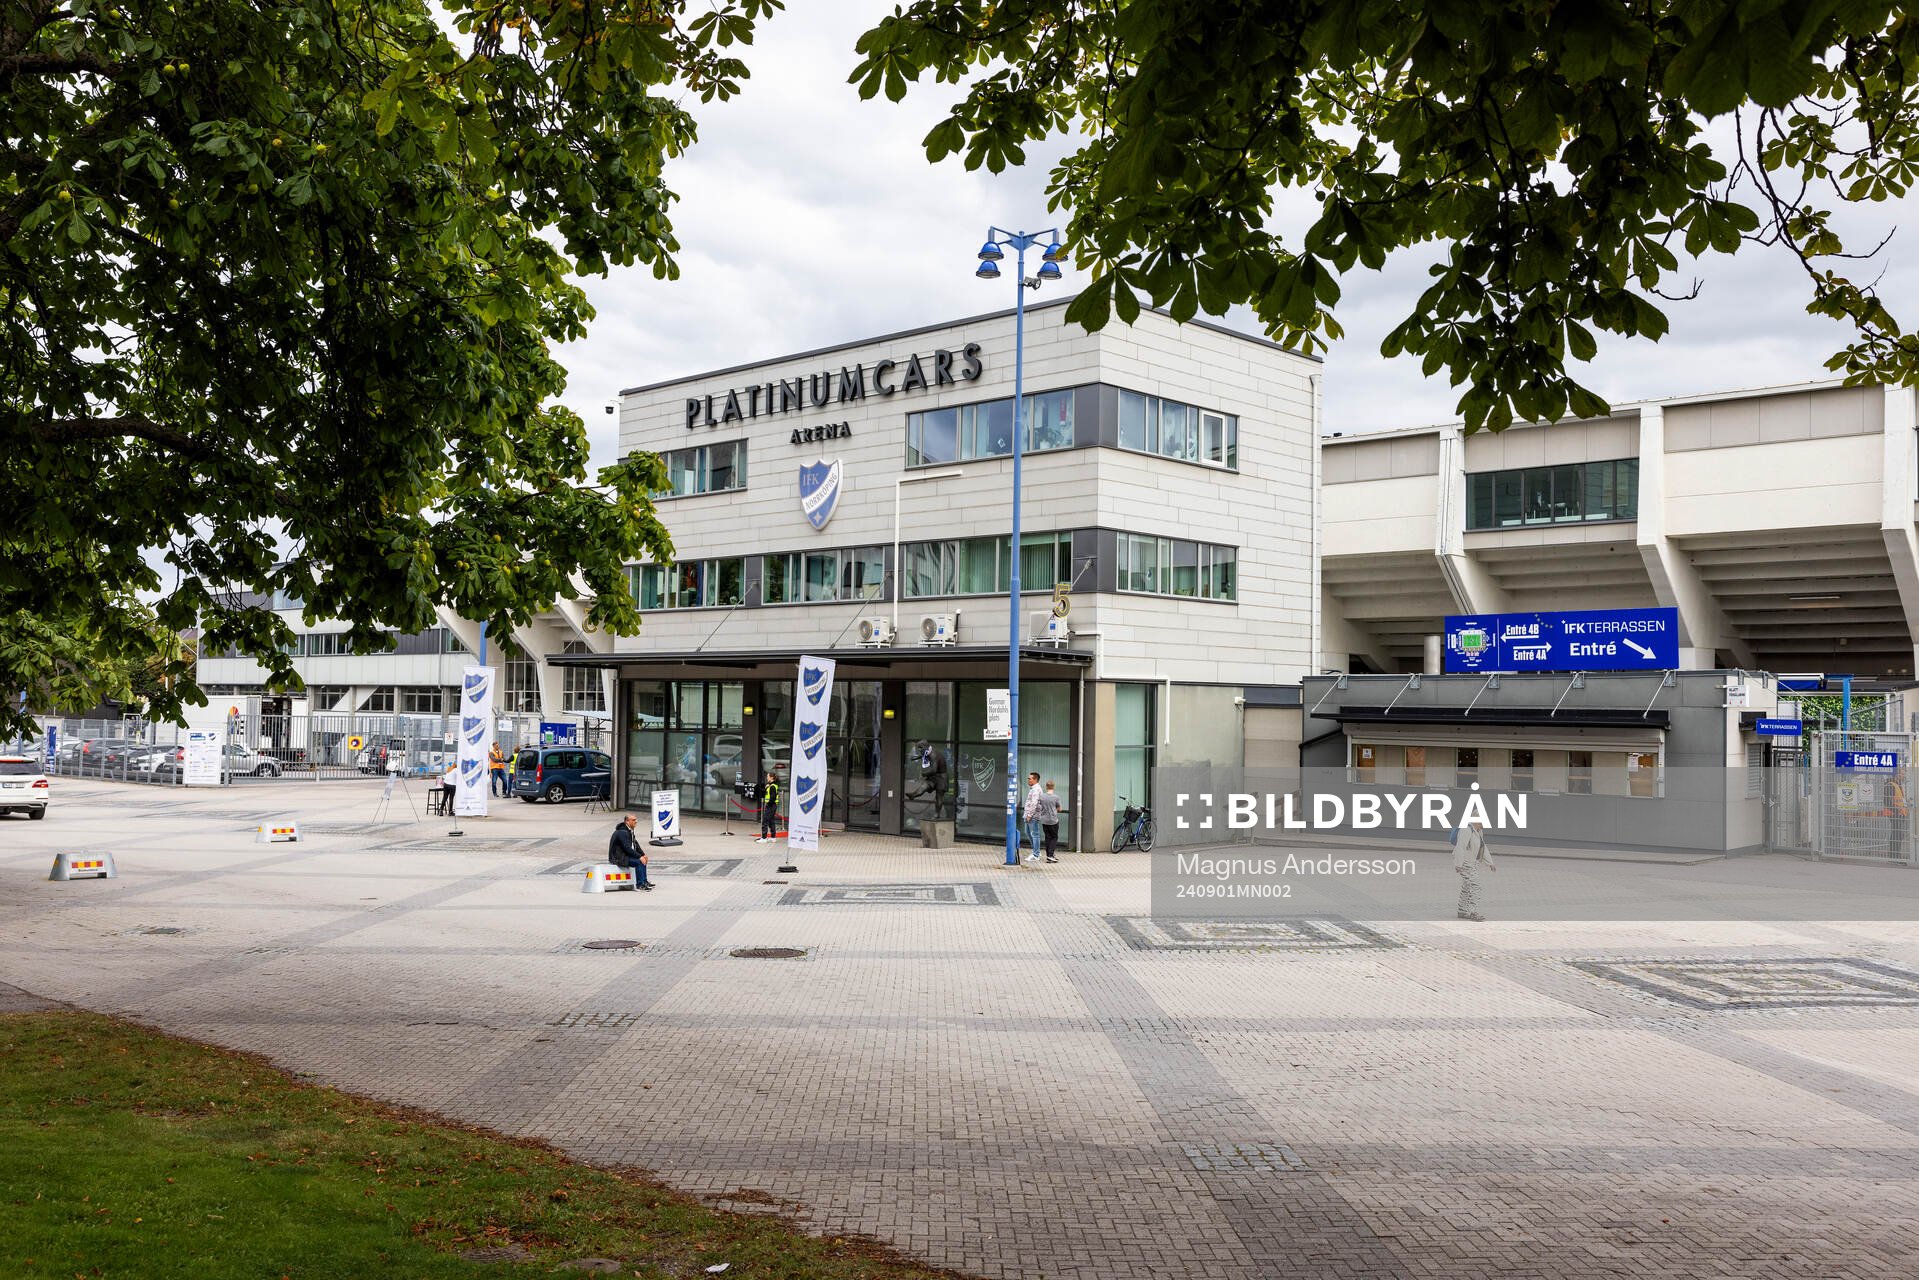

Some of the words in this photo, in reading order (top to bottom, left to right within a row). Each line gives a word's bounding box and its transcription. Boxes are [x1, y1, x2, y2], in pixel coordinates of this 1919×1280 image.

[686, 342, 983, 429] PLATINUMCARS
[790, 421, 852, 444] ARENA
[803, 473, 820, 487] IFK
[1506, 624, 1527, 635] Entré
[1528, 624, 1539, 634] 4B
[1513, 649, 1534, 660] Entré
[1536, 650, 1547, 660] 4A
[1570, 641, 1617, 656] Entré
[1854, 754, 1878, 765] Entré
[1880, 755, 1893, 766] 4A
